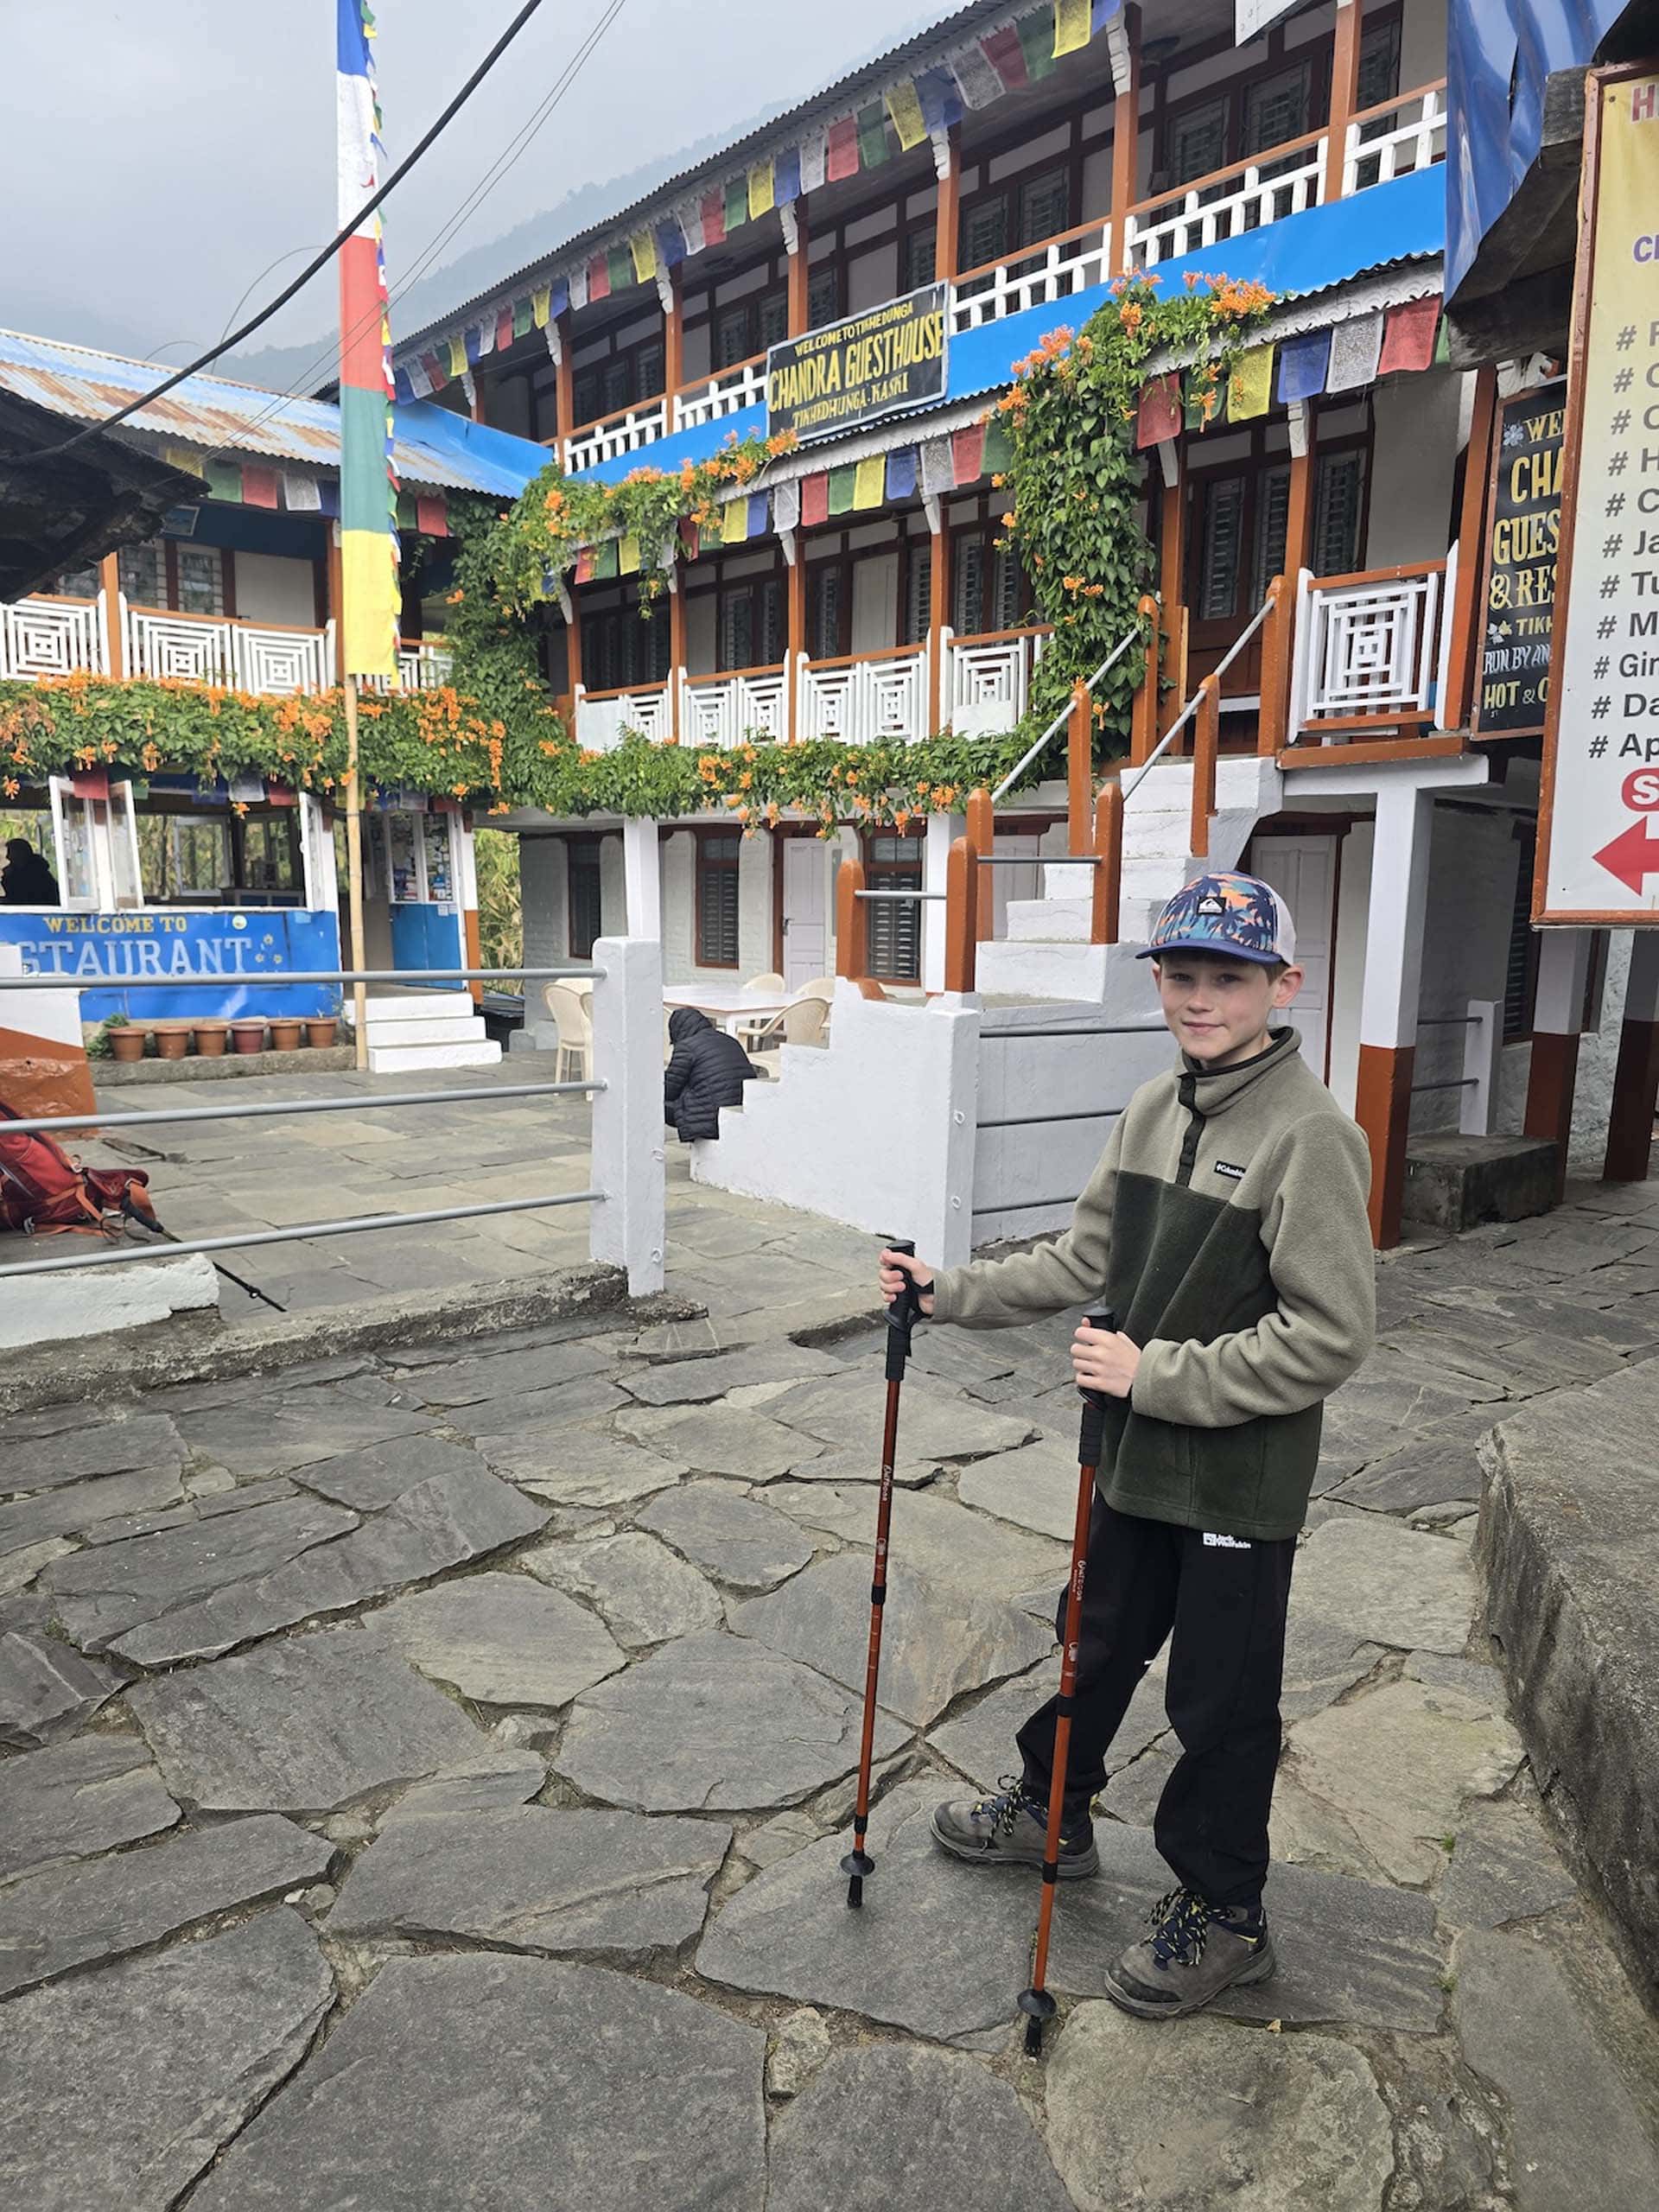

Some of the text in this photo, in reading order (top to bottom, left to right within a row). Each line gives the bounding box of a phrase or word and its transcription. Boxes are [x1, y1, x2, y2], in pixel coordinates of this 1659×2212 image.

[1633, 234, 1659, 263] C
[795, 329, 842, 357] WELCOME
[843, 326, 855, 340] TO
[769, 310, 944, 413] CHANDRA GUESTHOUSE
[1522, 409, 1566, 443] WE
[1493, 508, 1560, 564] GUES
[1490, 570, 1513, 610] &
[1511, 645, 1531, 671] BY
[1484, 680, 1521, 709] HOT
[1522, 689, 1535, 704] &
[42, 916, 187, 934] WELCOME TO
